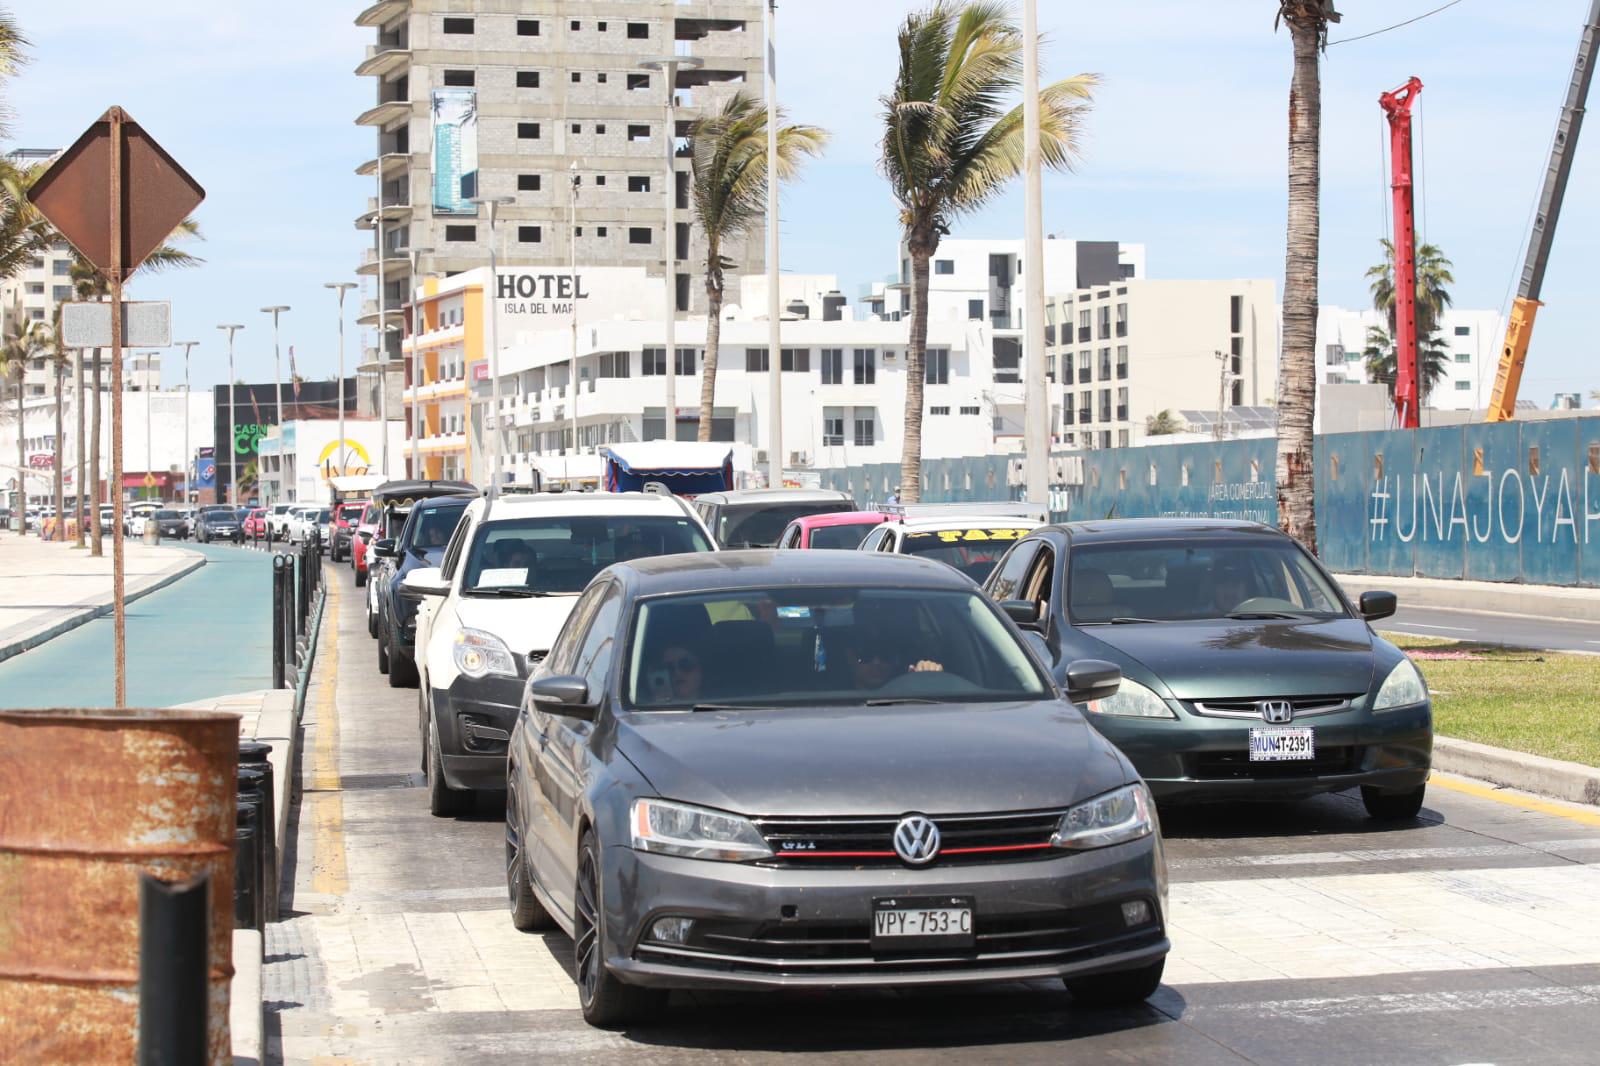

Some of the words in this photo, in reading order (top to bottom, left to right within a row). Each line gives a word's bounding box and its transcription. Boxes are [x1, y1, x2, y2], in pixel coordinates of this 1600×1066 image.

[496, 274, 589, 299] HOTEL
[504, 303, 526, 314] ISLA
[530, 303, 547, 314] DEL
[234, 424, 270, 435] CASIN
[1230, 481, 1273, 500] COMERCIAL
[1253, 735, 1311, 752] MUN4T-2391
[876, 910, 970, 934] VPY-753-C
